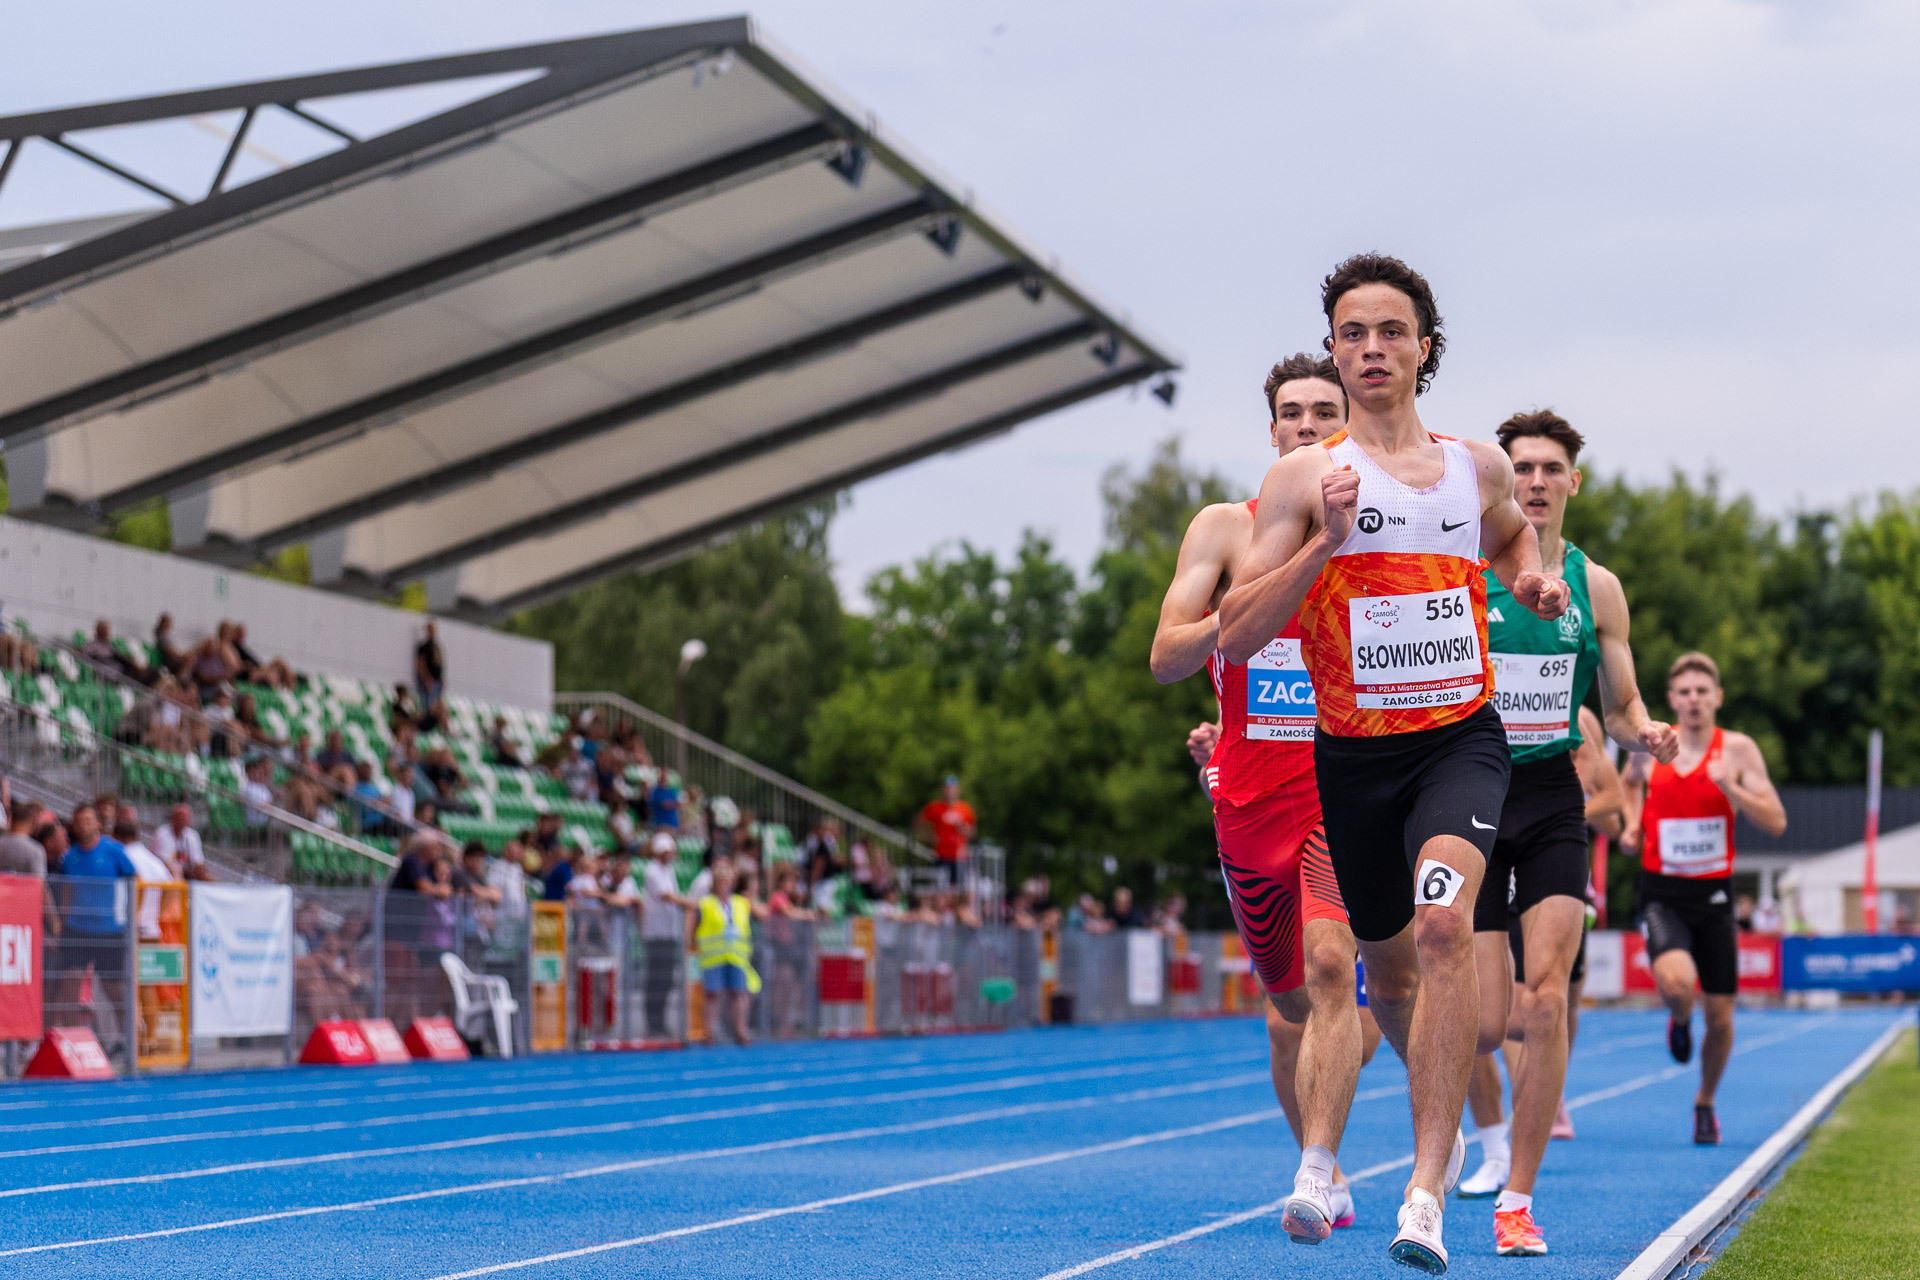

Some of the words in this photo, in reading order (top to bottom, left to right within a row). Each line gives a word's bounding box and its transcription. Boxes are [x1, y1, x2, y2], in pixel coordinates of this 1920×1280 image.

[1388, 516, 1406, 526] NN
[1372, 609, 1398, 618] ZAMOŚĆ
[1426, 595, 1464, 621] 556
[1267, 650, 1290, 658] ZAMOŚĆ
[1357, 635, 1474, 670] SŁOWIKOWSKI
[1540, 660, 1568, 677] 695
[1379, 685, 1396, 693] PZLA
[1397, 683, 1441, 692] Mistrzostwa
[1441, 678, 1460, 688] Polski
[1461, 677, 1474, 685] U20
[1382, 692, 1433, 706] ZAMOŚĆ
[1435, 691, 1462, 703] 2026
[1491, 691, 1569, 712] RBANOWICZ
[1269, 728, 1315, 738] ZAMOŚĆ
[1506, 732, 1535, 741] MOŚĆ
[1537, 732, 1555, 741] 2026
[1423, 867, 1452, 901] 6
